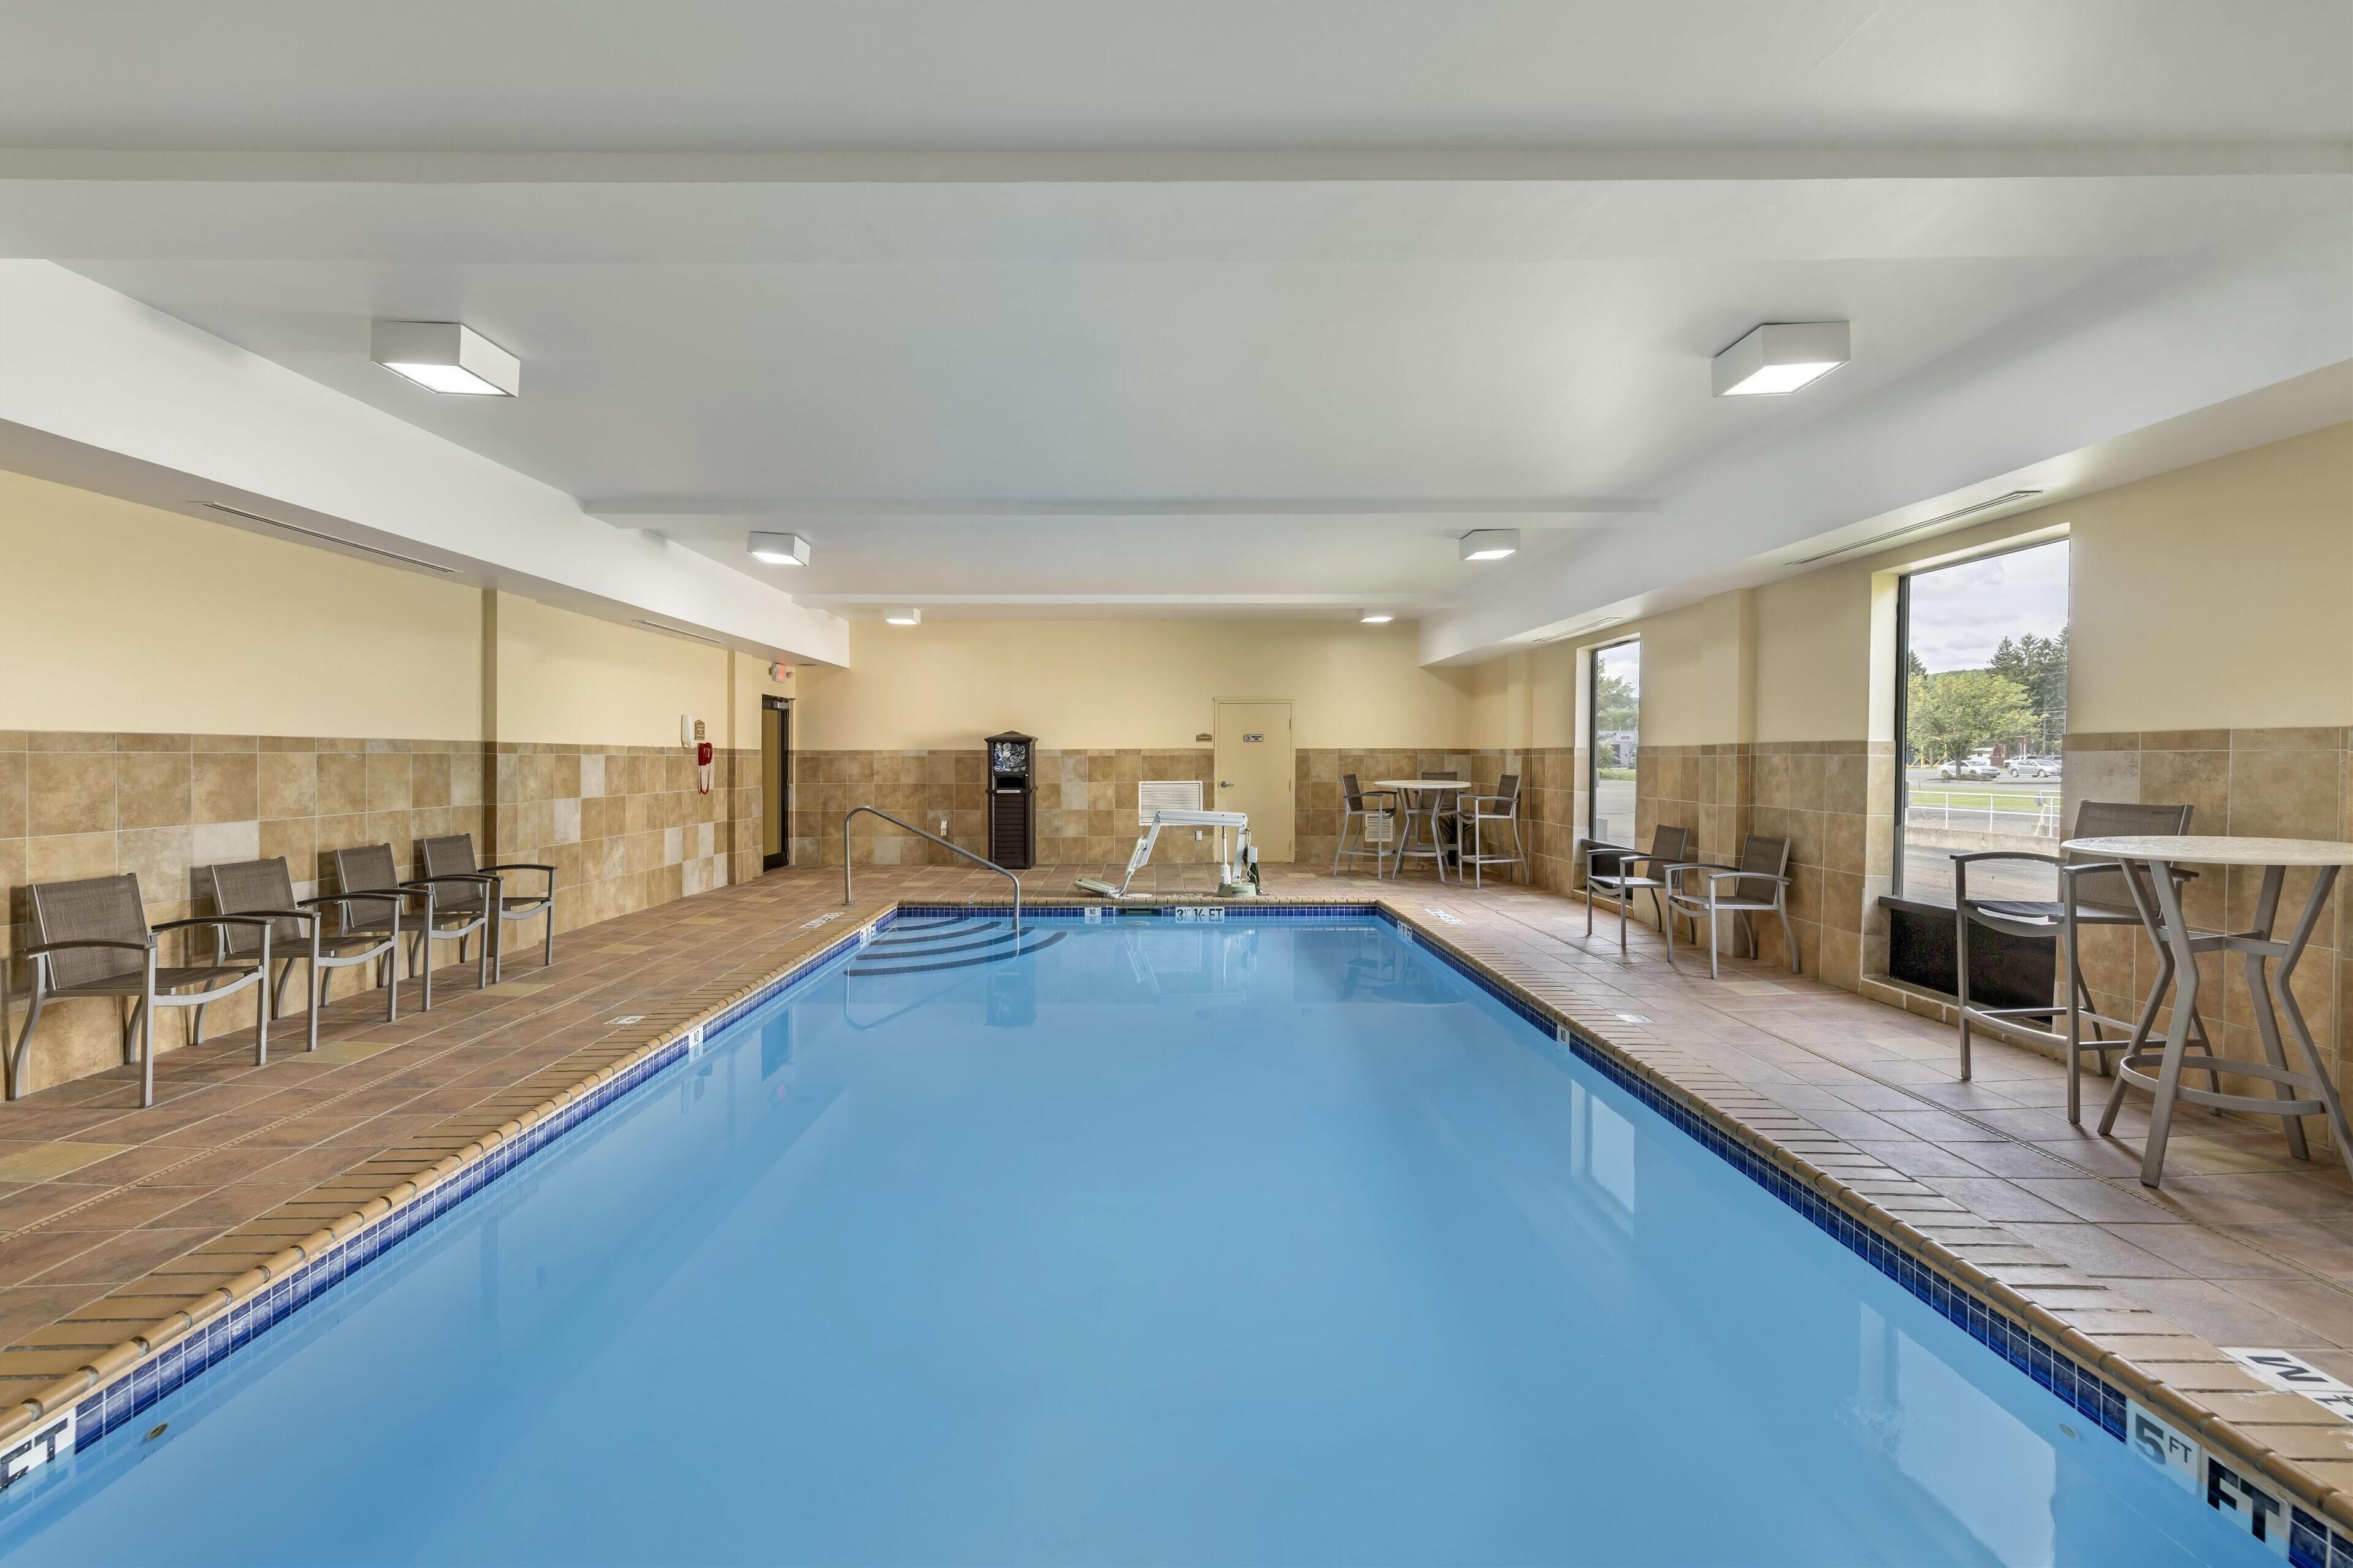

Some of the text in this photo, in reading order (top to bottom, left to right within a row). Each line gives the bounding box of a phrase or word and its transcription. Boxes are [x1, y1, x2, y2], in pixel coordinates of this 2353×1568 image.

[694, 1030, 699, 1043] NO
[1560, 1028, 1566, 1042] NO
[2135, 1412, 2192, 1466] 5 FT
[2207, 1456, 2281, 1544] FT
